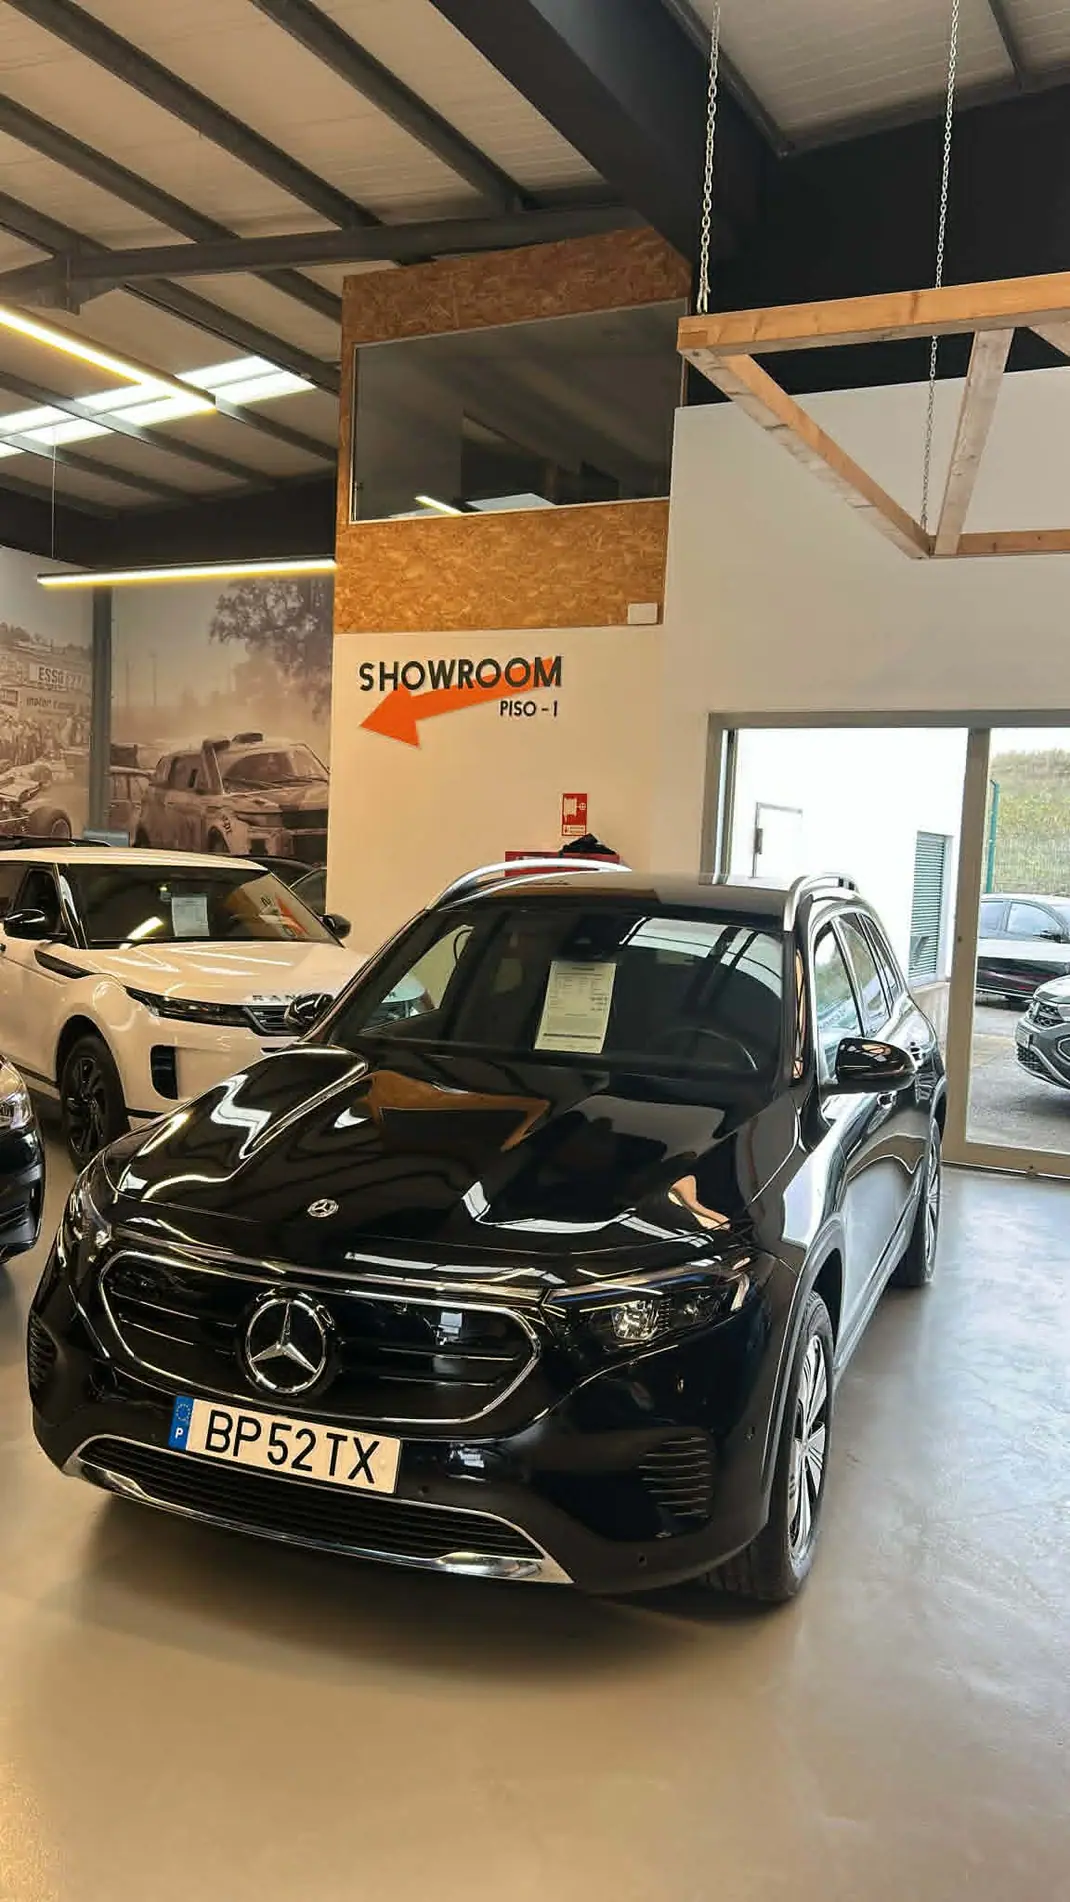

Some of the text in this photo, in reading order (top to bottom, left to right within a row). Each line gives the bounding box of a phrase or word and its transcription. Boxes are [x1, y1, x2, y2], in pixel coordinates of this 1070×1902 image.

[359, 655, 562, 692] SHOWROOM
[500, 700, 537, 717] PISO
[175, 1428, 184, 1439] P
